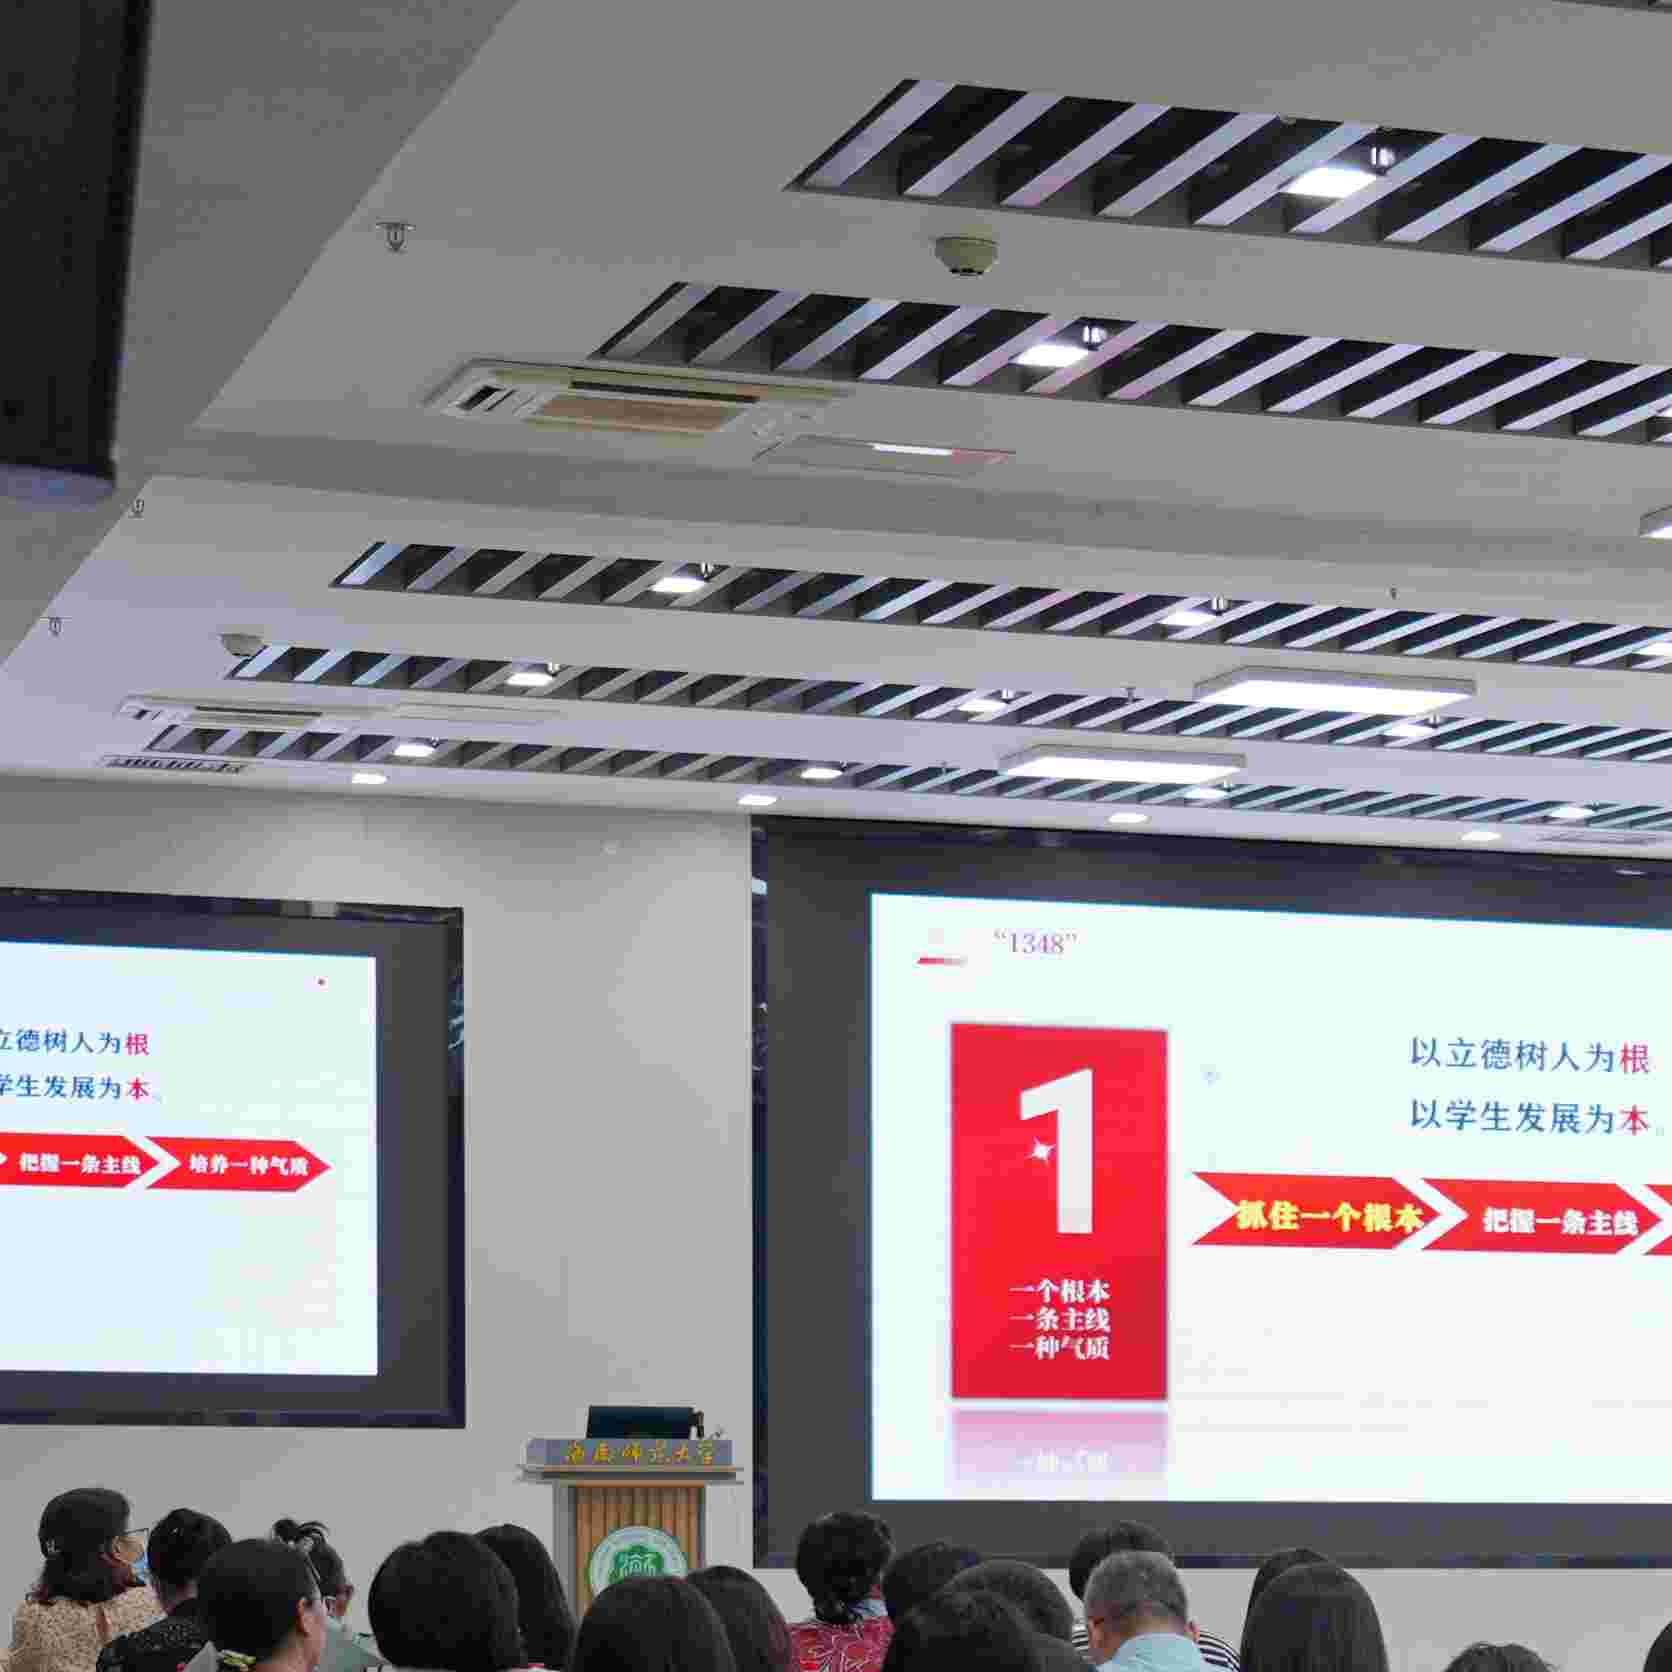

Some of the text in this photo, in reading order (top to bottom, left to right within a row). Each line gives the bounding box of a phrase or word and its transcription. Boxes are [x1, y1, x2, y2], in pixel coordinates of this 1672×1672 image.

[1411, 1036, 1651, 1074] 以立德树人为根
[19, 1151, 142, 1175] 把握一条主线
[1020, 1068, 1093, 1234] 1
[189, 1153, 309, 1177] 培养一种气质
[1236, 1200, 1424, 1233] 抓住一个根本
[1483, 1207, 1639, 1236] 把握一条主线
[1009, 1279, 1111, 1304] 一个根本
[1009, 1307, 1111, 1333] 一条主线
[1009, 1335, 1110, 1361] 一种气质
